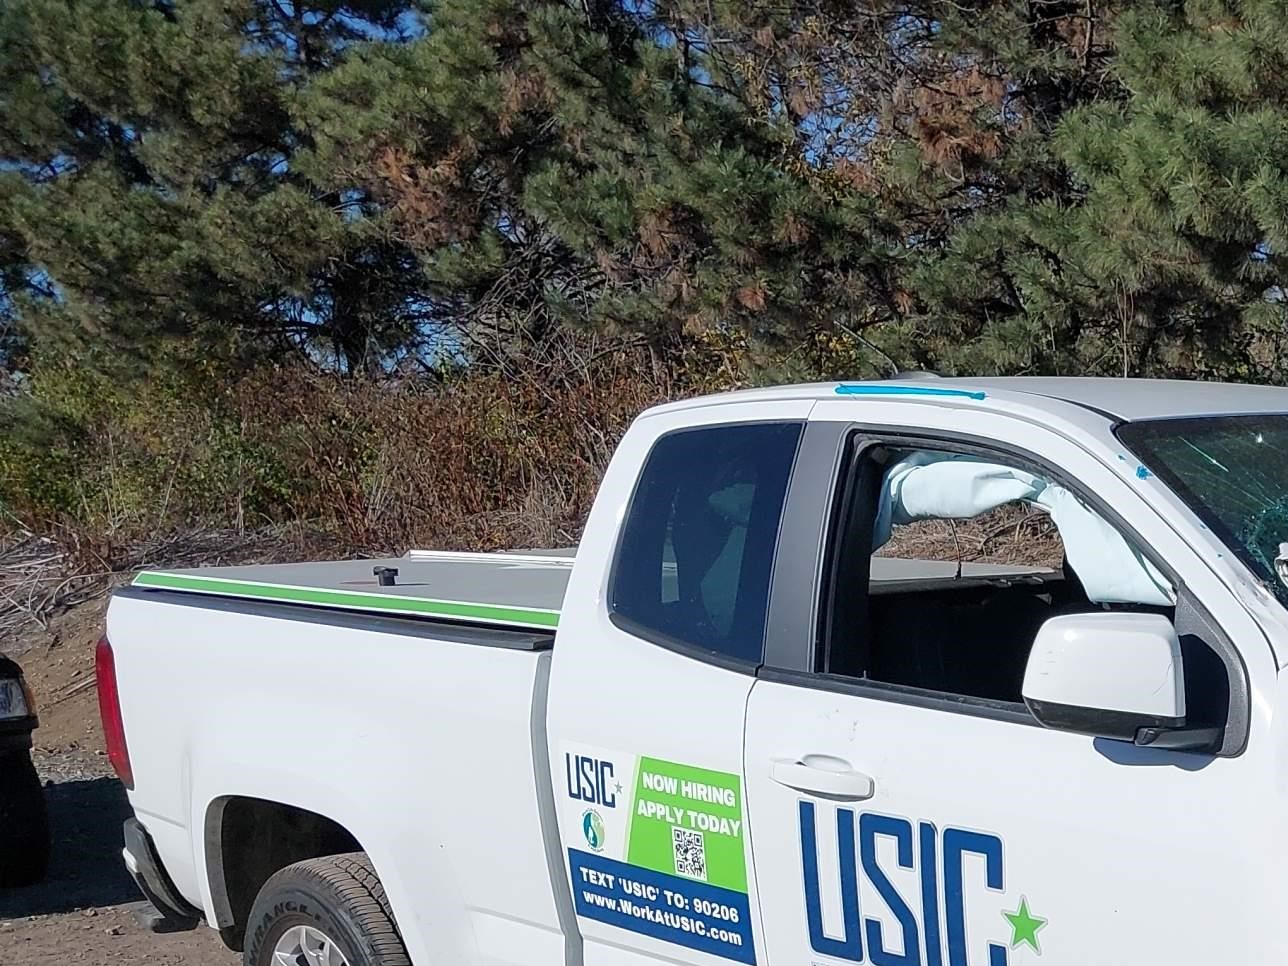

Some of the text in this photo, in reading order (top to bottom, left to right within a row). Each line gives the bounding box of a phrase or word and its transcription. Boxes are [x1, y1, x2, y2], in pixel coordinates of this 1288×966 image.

[566, 752, 616, 808] USIC
[642, 771, 736, 808] NOW HIRING
[638, 799, 741, 837] APPLY TODAY
[580, 866, 739, 924] TEXT 'USIC' TO: 90206
[583, 890, 743, 946] www.WorkAtUSIC.com
